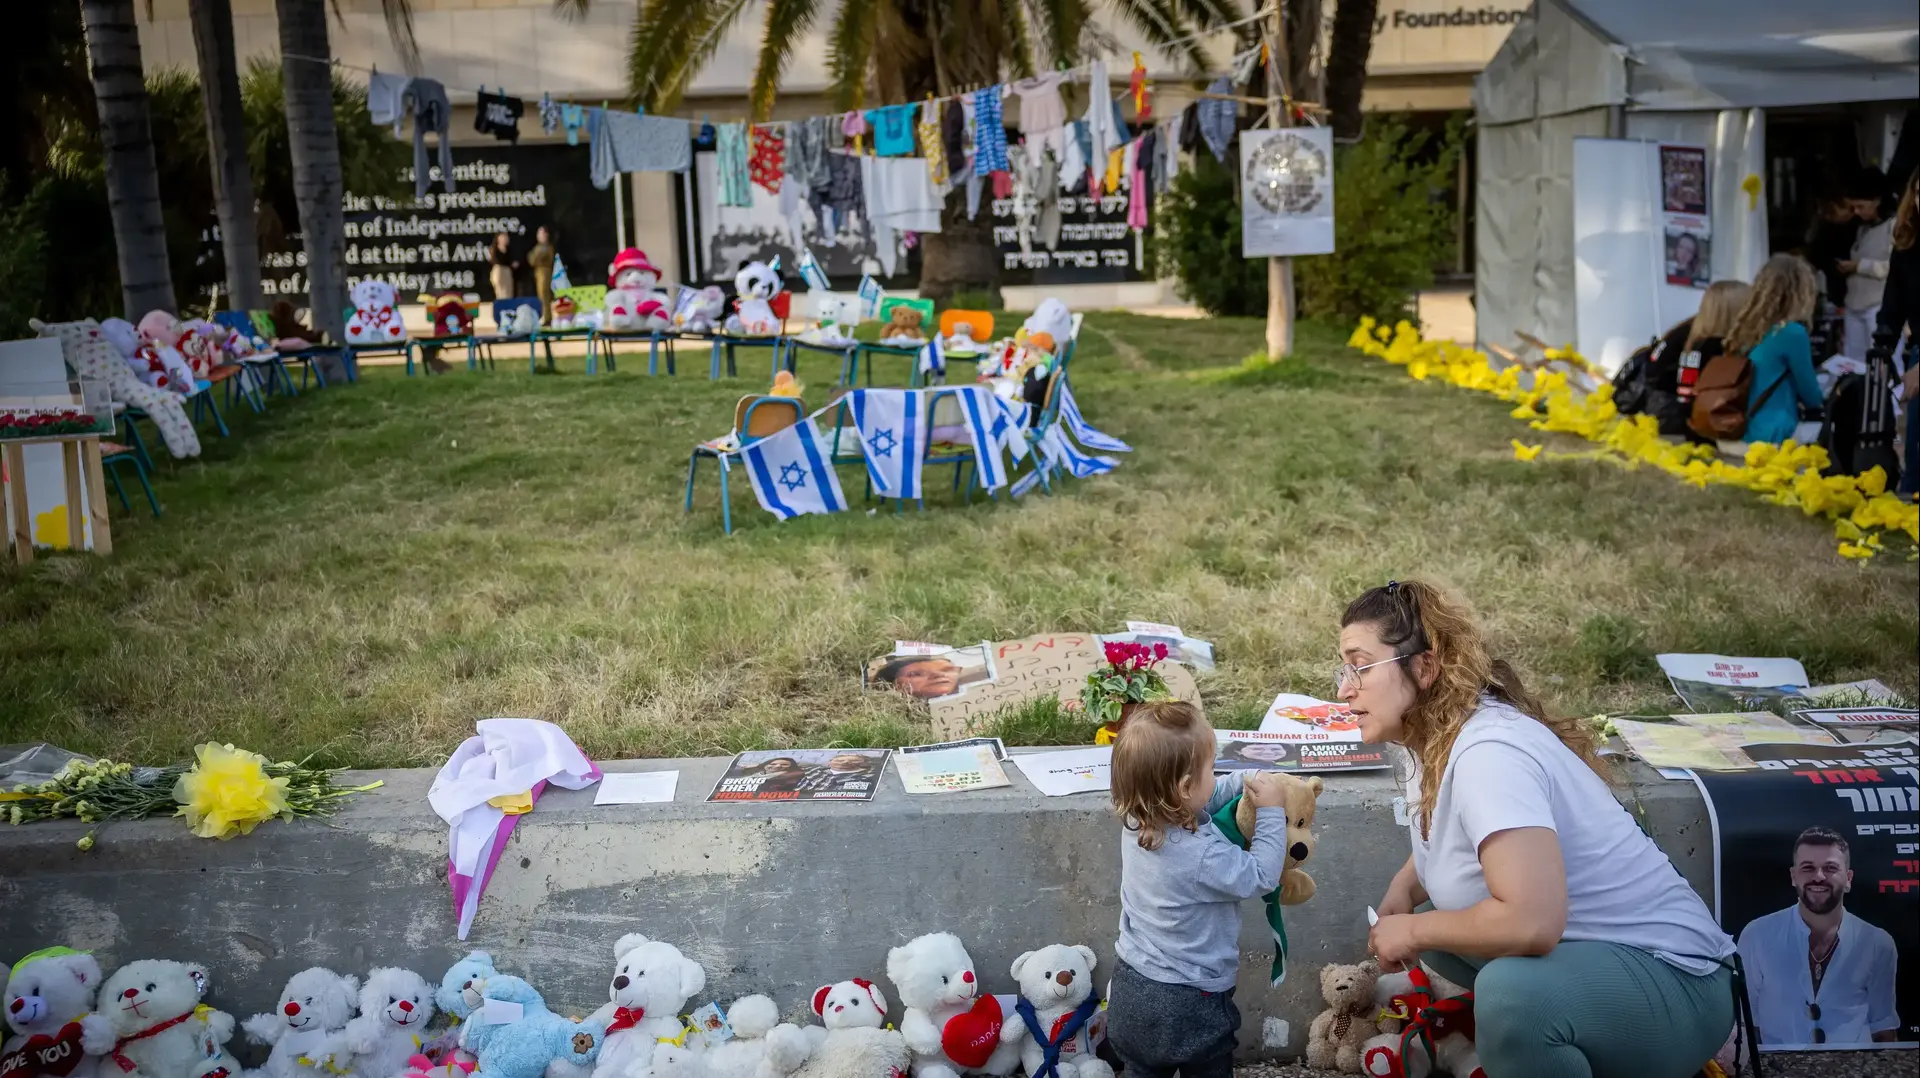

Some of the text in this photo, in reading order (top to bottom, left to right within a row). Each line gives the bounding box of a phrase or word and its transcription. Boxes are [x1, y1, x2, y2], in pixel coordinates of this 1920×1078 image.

[1393, 6, 1525, 29] Foundation
[438, 185, 546, 213] proclaimed
[361, 216, 383, 236] of
[384, 213, 527, 239] Independence,
[361, 244, 384, 265] at
[384, 243, 418, 264] the
[419, 241, 449, 263] Tel
[279, 273, 301, 293] of
[433, 270, 475, 289] 1948
[1229, 731, 1330, 741] ADI SHOHAM (38)
[1311, 743, 1359, 751] WHOLE
[1858, 747, 1914, 757] לא
[723, 777, 767, 785] BRING
[1793, 768, 1885, 784] אחד
[714, 791, 800, 800] HOME NOW!
[720, 784, 759, 792] THEM
[1, 1040, 71, 1076] OVE YOU
